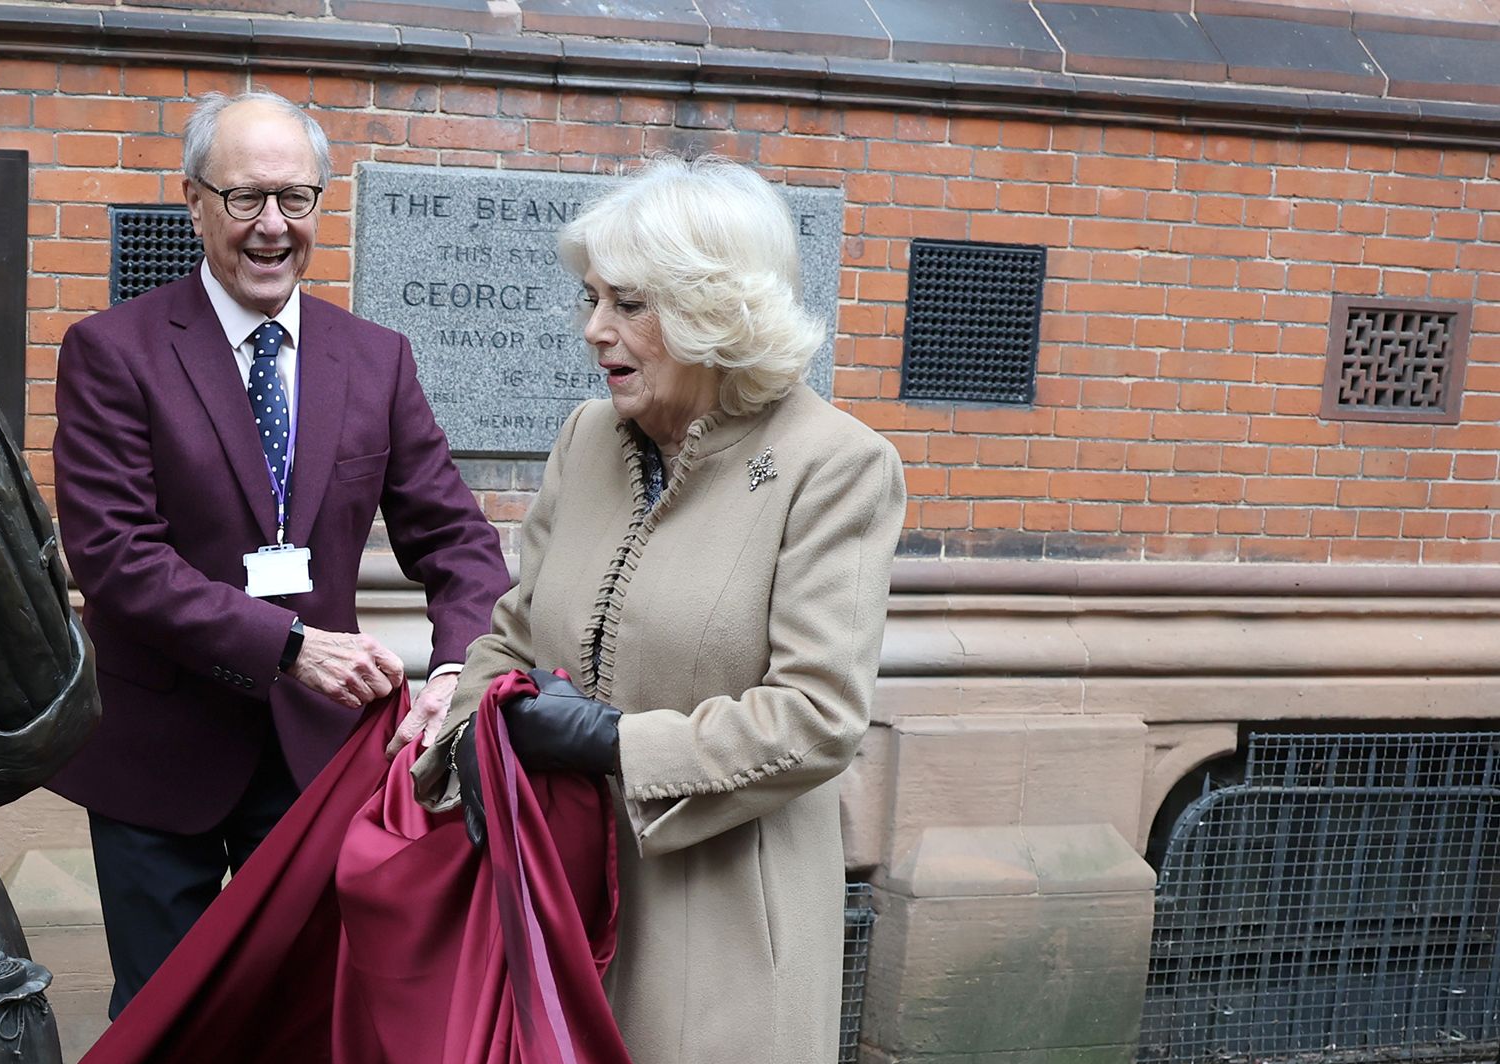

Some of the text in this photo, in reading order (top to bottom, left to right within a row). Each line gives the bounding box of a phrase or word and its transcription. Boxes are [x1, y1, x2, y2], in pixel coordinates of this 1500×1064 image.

[384, 193, 451, 217] THE
[438, 245, 558, 266] THIS STO
[402, 281, 543, 310] GEORGE
[440, 329, 572, 351] MAYOR OF
[479, 414, 536, 431] HENRY
